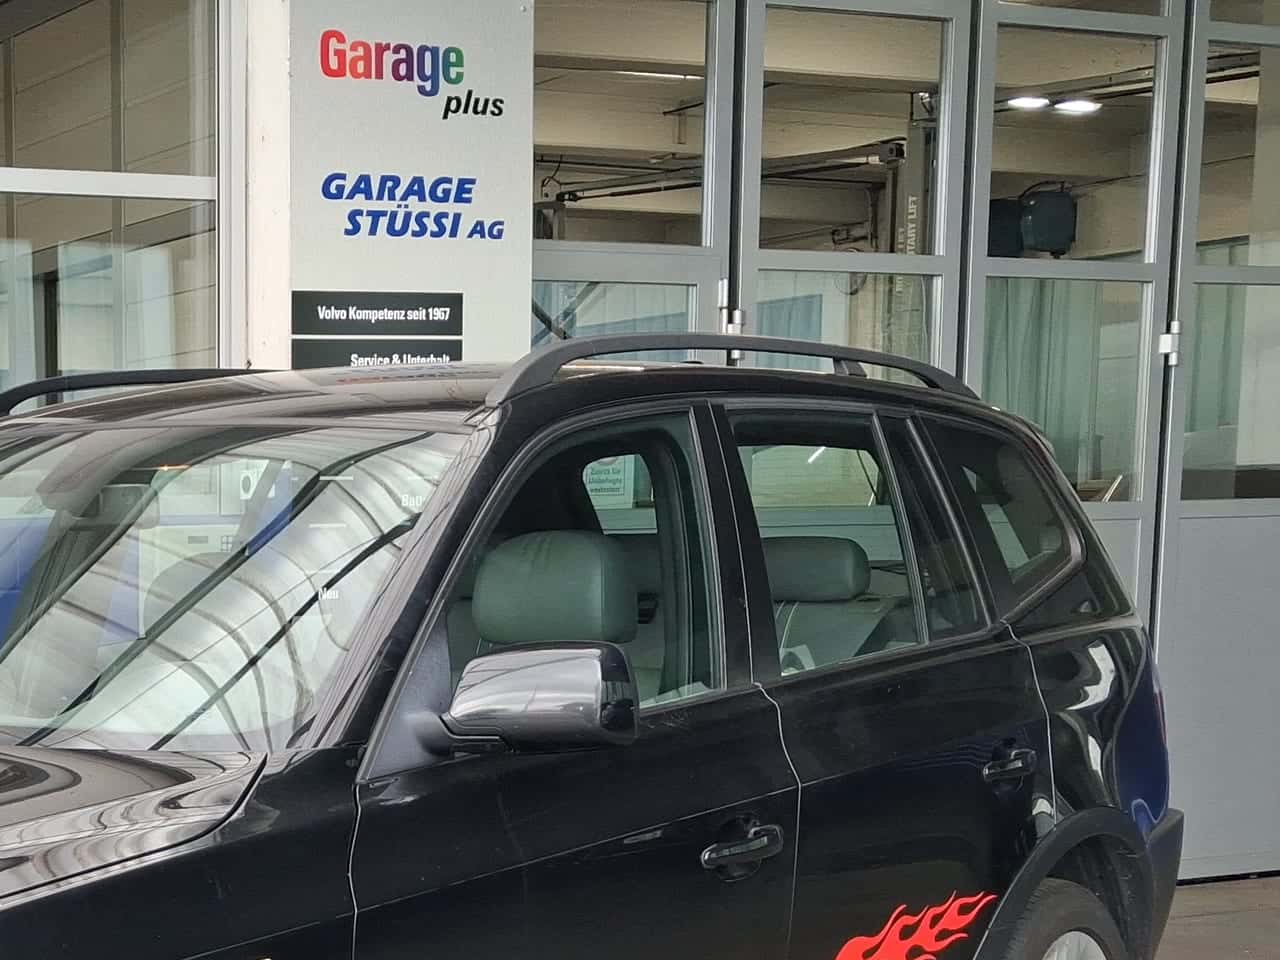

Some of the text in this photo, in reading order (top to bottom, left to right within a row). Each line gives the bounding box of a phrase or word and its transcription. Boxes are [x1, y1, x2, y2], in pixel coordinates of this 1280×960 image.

[320, 30, 464, 97] Garage
[443, 90, 505, 120] plus
[321, 173, 477, 204] GARAGE
[344, 204, 505, 239] STÜSSI AG
[317, 306, 450, 323] Volvo Kompetenz seit 1967
[351, 354, 390, 367] Service
[392, 354, 400, 364] &
